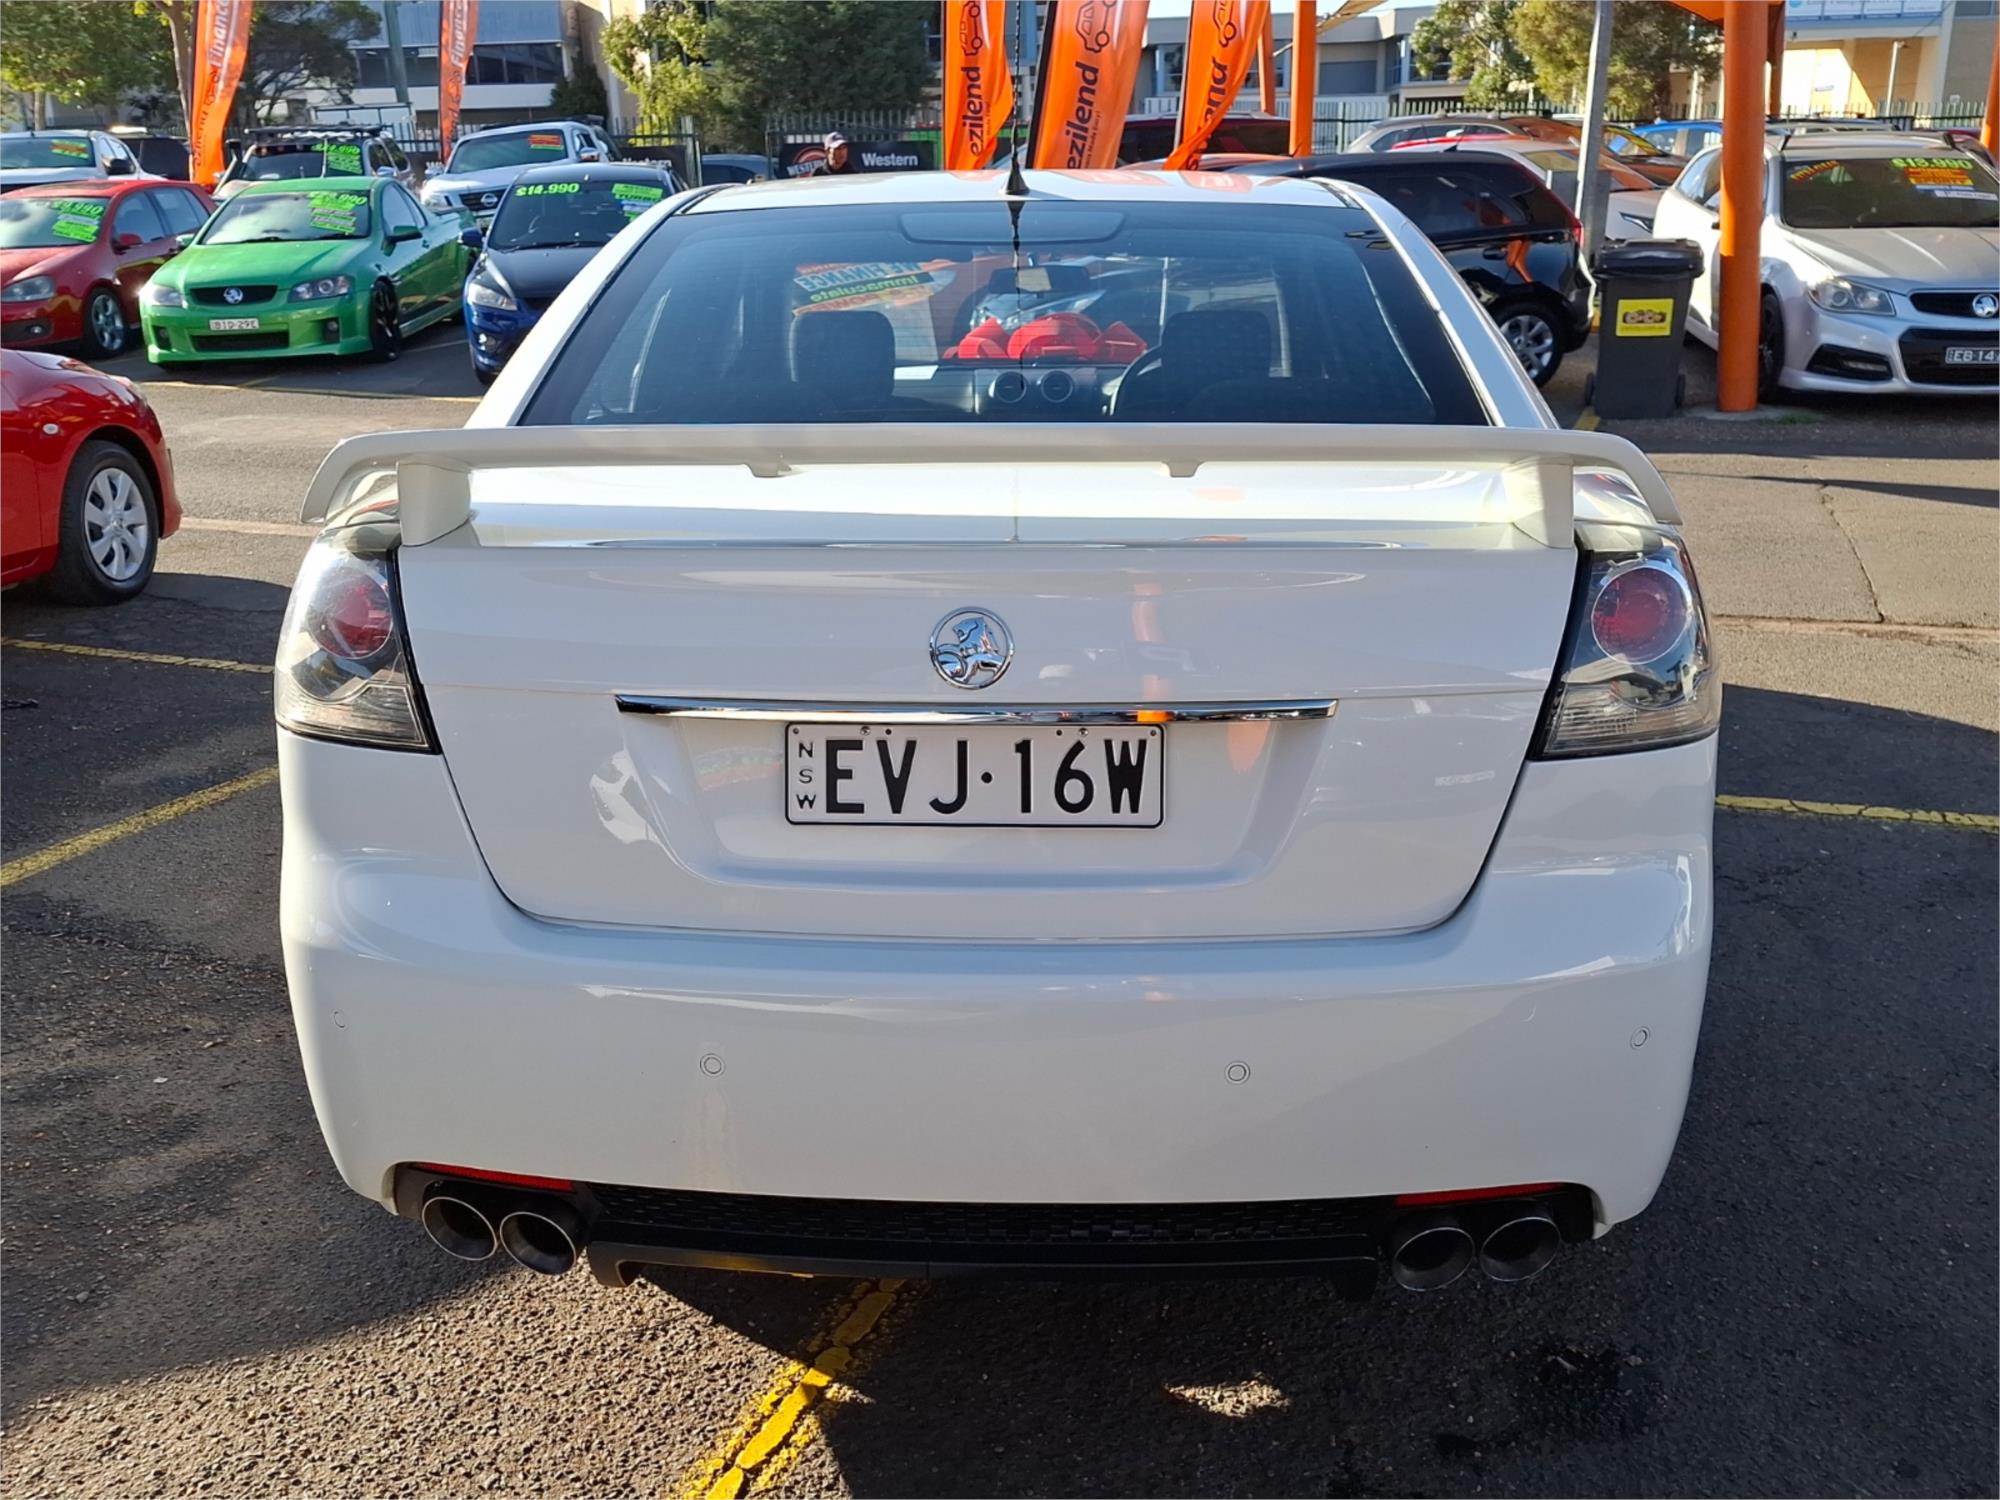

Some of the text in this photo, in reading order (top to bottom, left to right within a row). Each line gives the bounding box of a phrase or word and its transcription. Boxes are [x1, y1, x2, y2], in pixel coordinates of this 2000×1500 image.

[961, 66, 984, 156] ezilend
[1066, 61, 1099, 169] ezilend
[861, 153, 918, 167] Western
